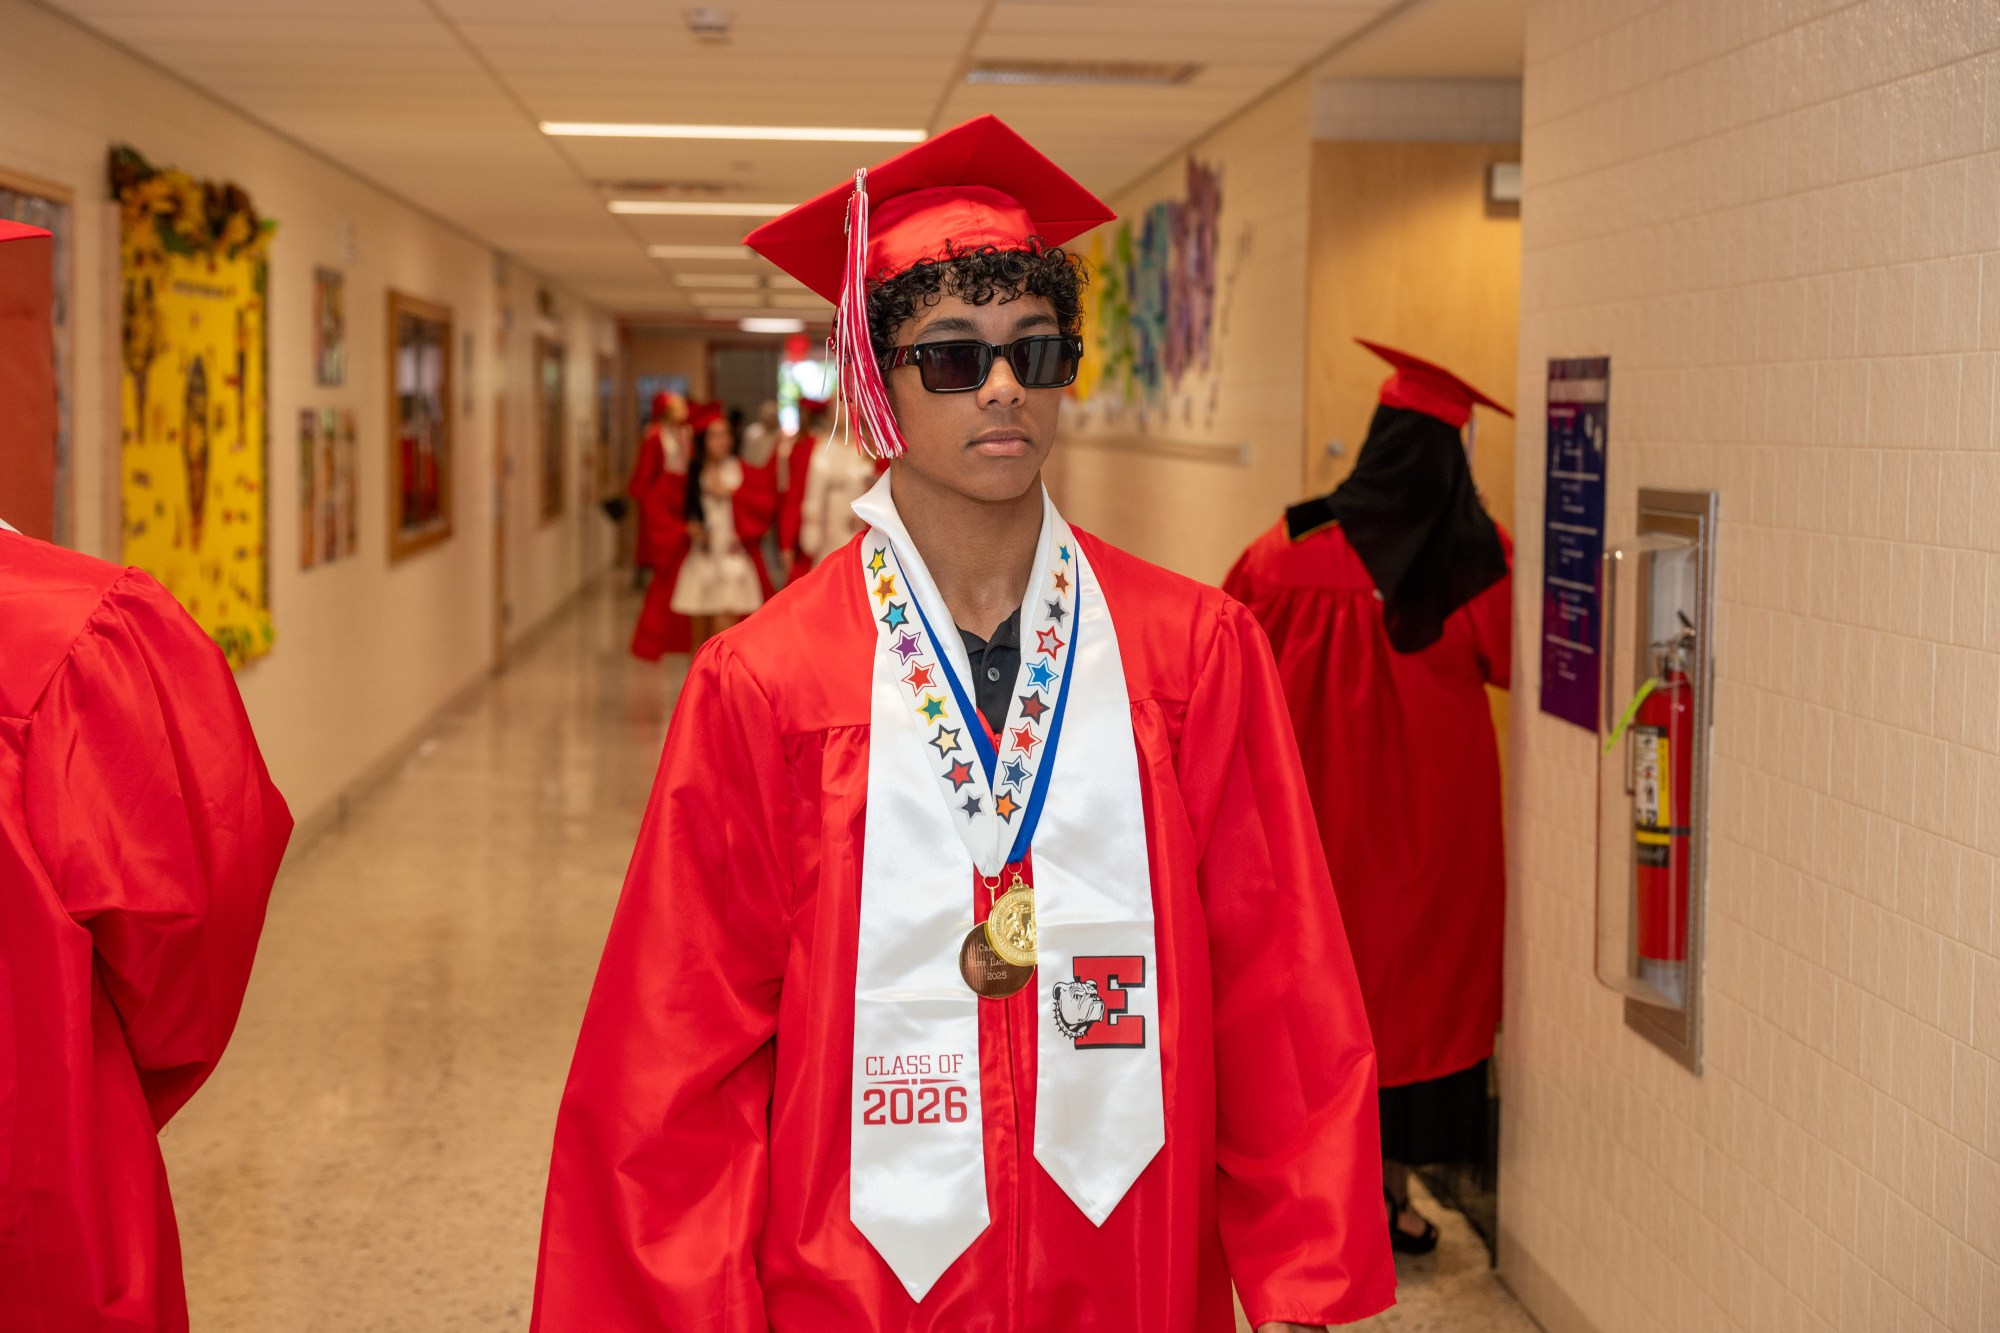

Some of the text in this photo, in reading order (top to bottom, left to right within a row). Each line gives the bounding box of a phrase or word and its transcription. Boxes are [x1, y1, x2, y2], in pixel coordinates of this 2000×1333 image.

[986, 971, 1007, 980] 2025
[865, 1054, 964, 1076] CLASS OF
[863, 1086, 968, 1125] 2026
